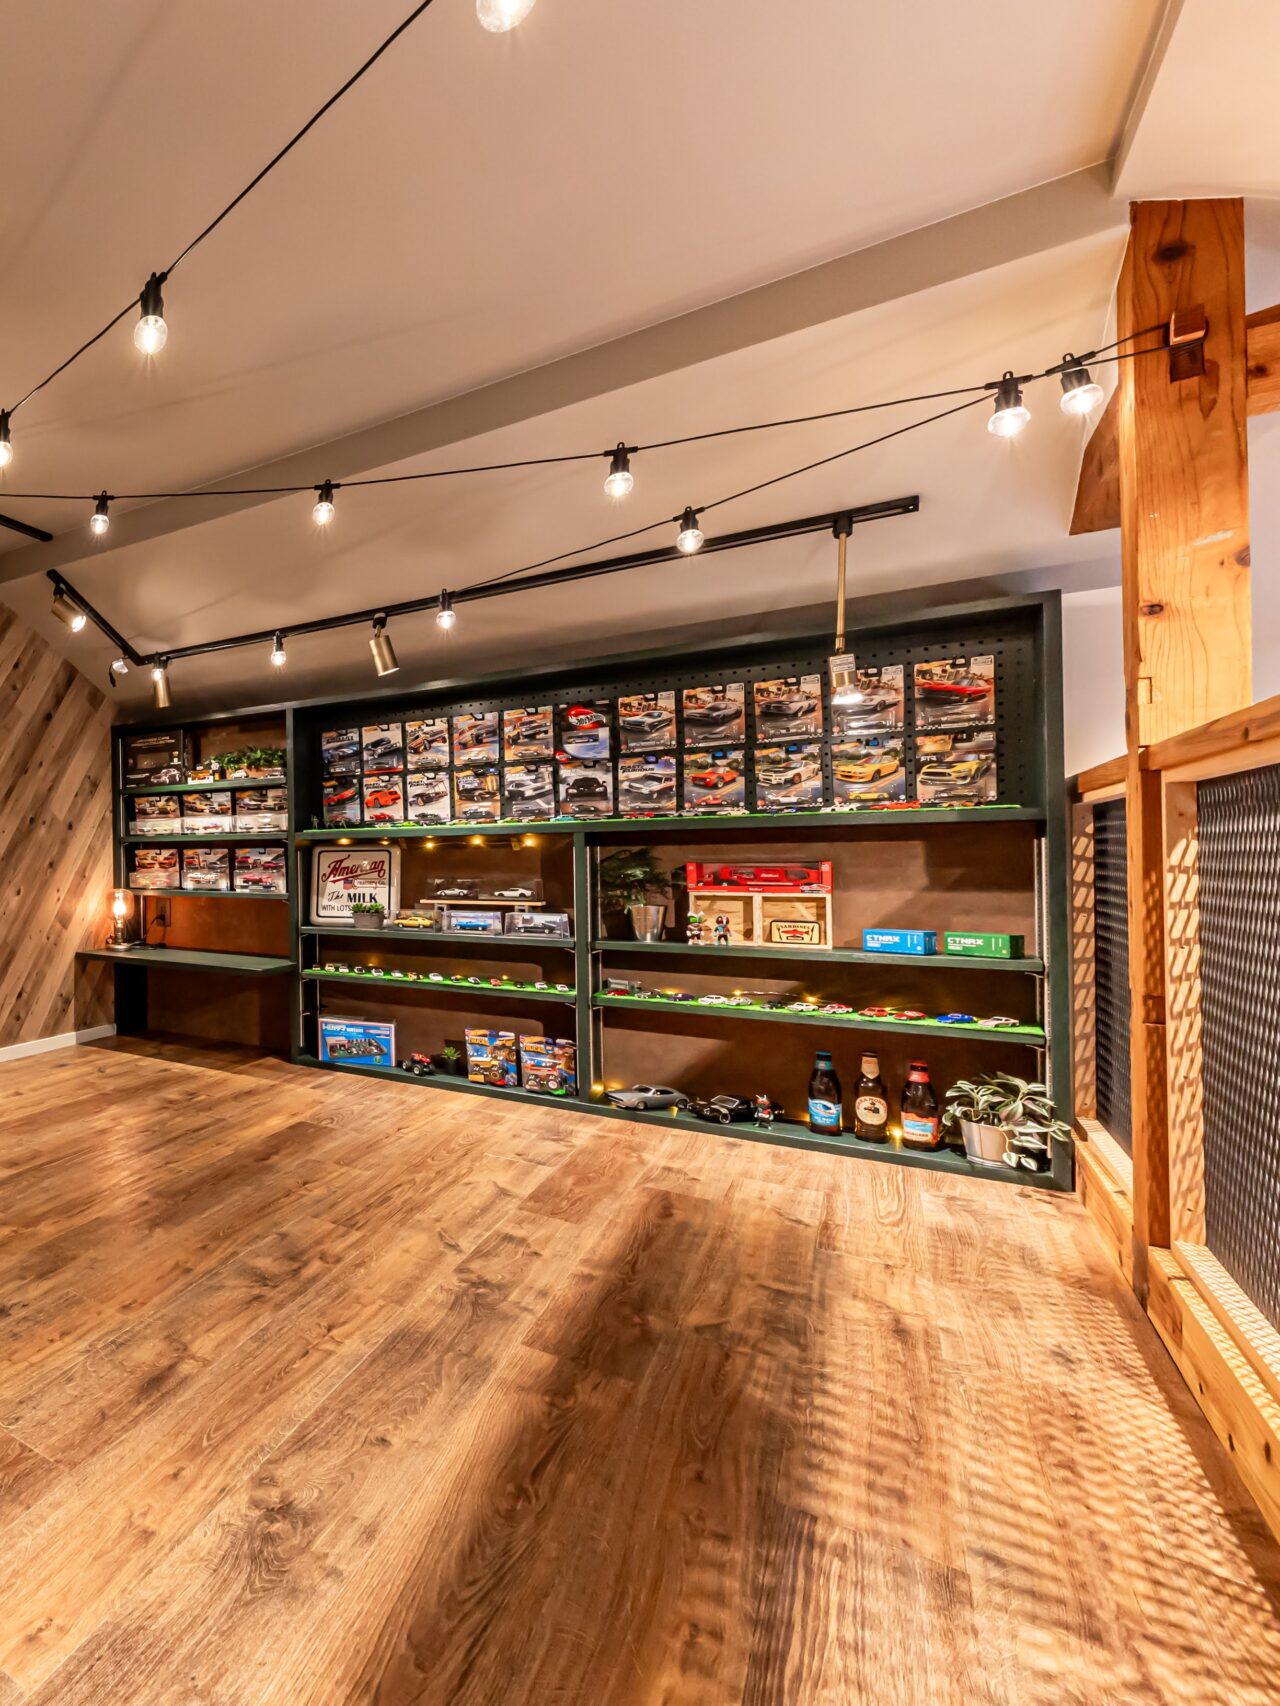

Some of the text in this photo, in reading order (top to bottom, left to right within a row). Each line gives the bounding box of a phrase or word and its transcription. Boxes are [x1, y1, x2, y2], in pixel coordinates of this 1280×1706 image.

[321, 854, 386, 882] Ameran
[328, 890, 378, 903] The MILK
[866, 934, 900, 943] CTNRX
[947, 937, 984, 946] CTNRX
